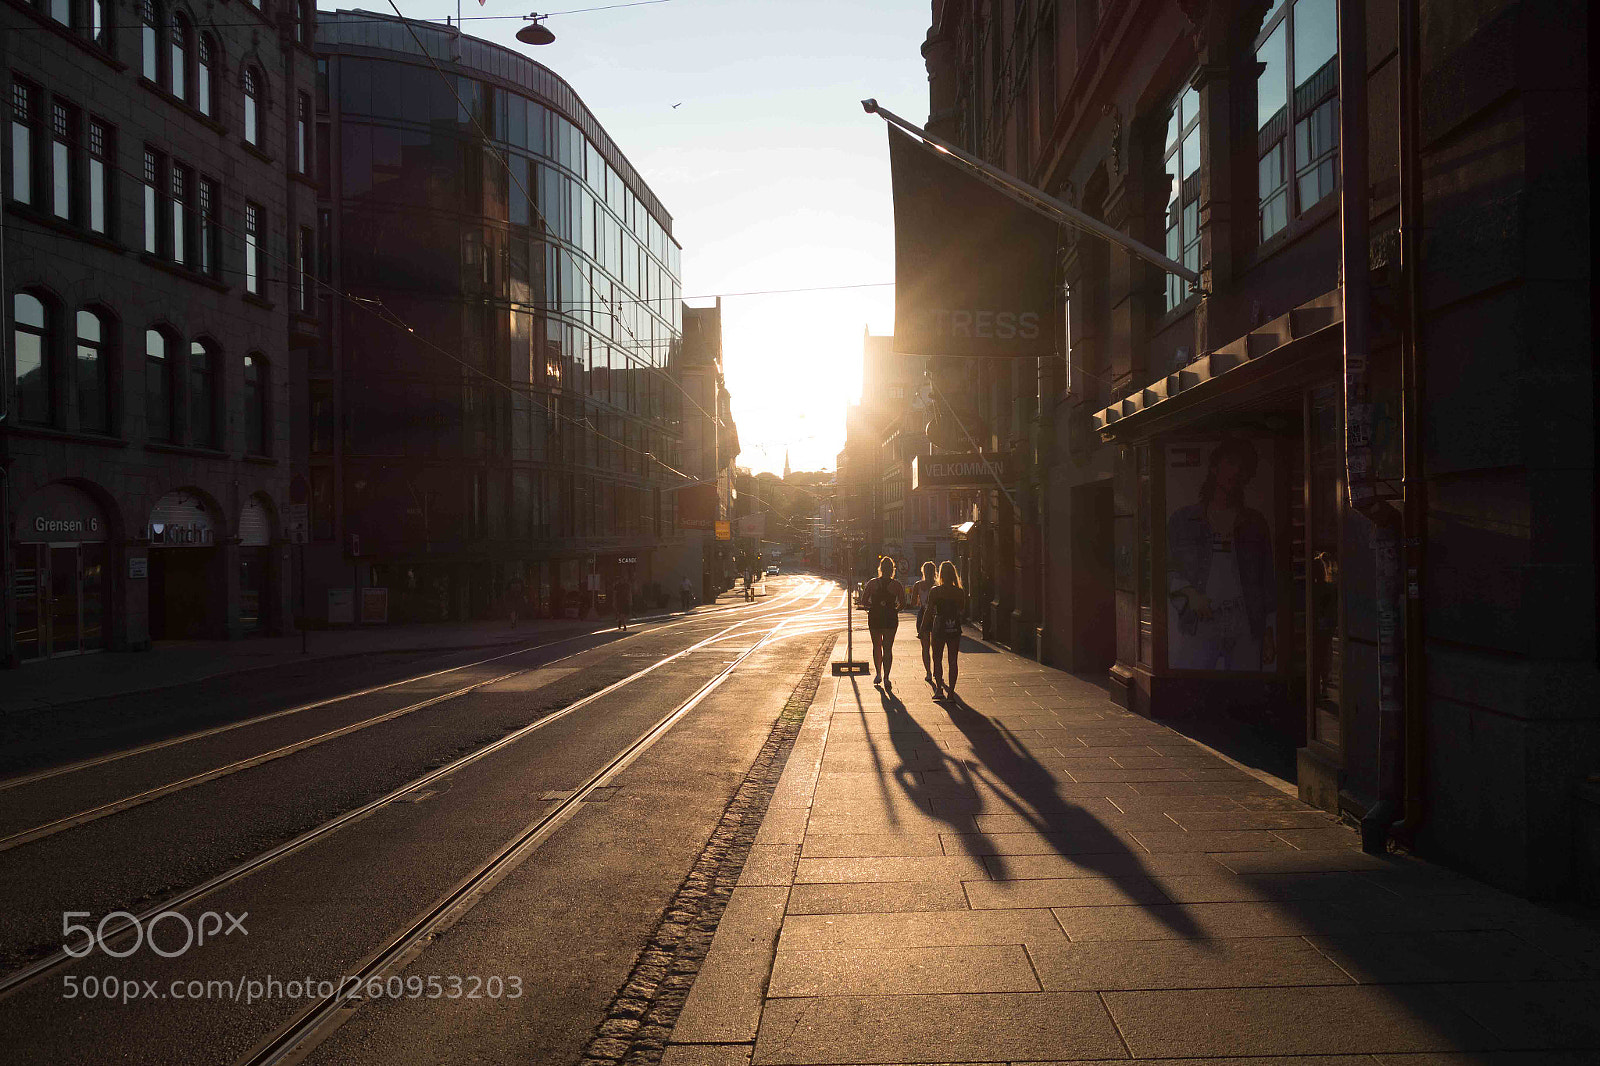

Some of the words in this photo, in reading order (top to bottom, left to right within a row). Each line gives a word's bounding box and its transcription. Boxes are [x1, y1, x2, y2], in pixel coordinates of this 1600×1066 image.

[911, 309, 1040, 339] TRESS
[924, 461, 1004, 477] VELKOMMEN
[35, 517, 82, 531] Grensen
